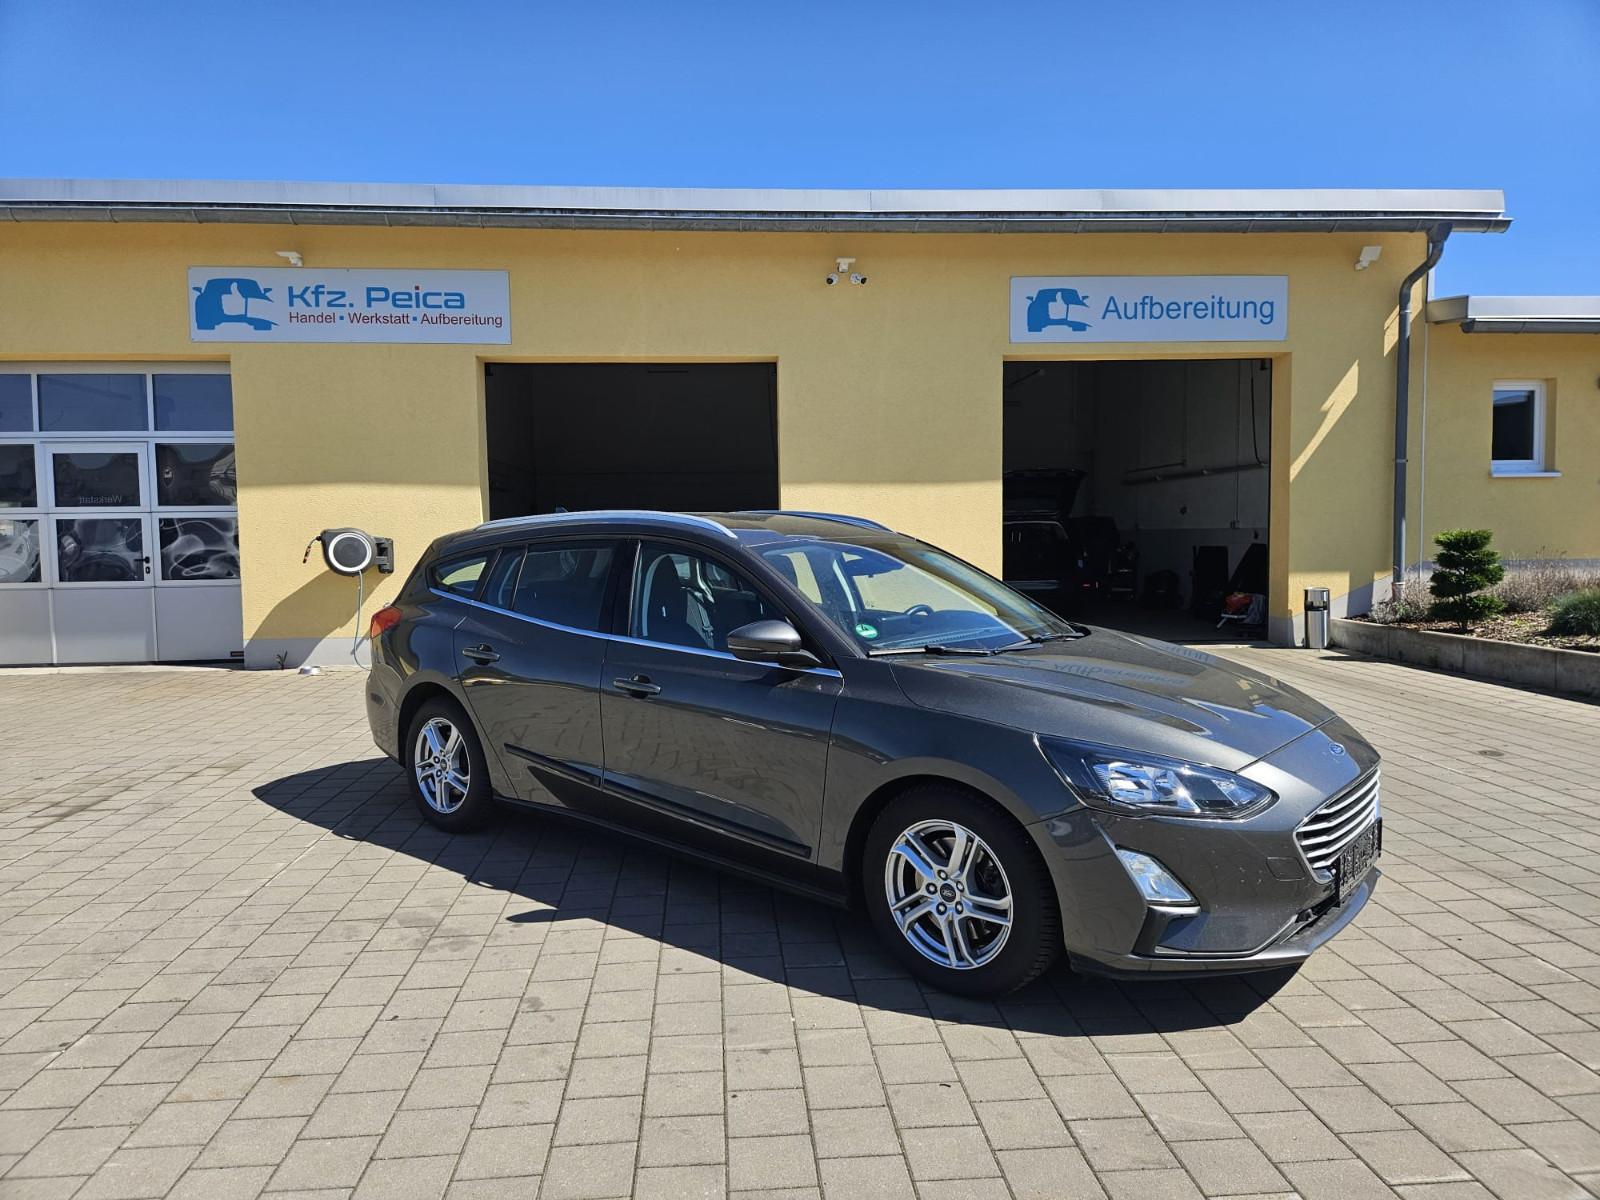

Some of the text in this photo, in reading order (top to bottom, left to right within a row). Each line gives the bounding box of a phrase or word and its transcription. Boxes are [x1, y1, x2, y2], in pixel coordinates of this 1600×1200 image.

[287, 284, 465, 309] Kfz. Peica
[289, 311, 503, 328] Handel Werkstatt Aufbereitung
[1101, 295, 1275, 325] Aufbereitung
